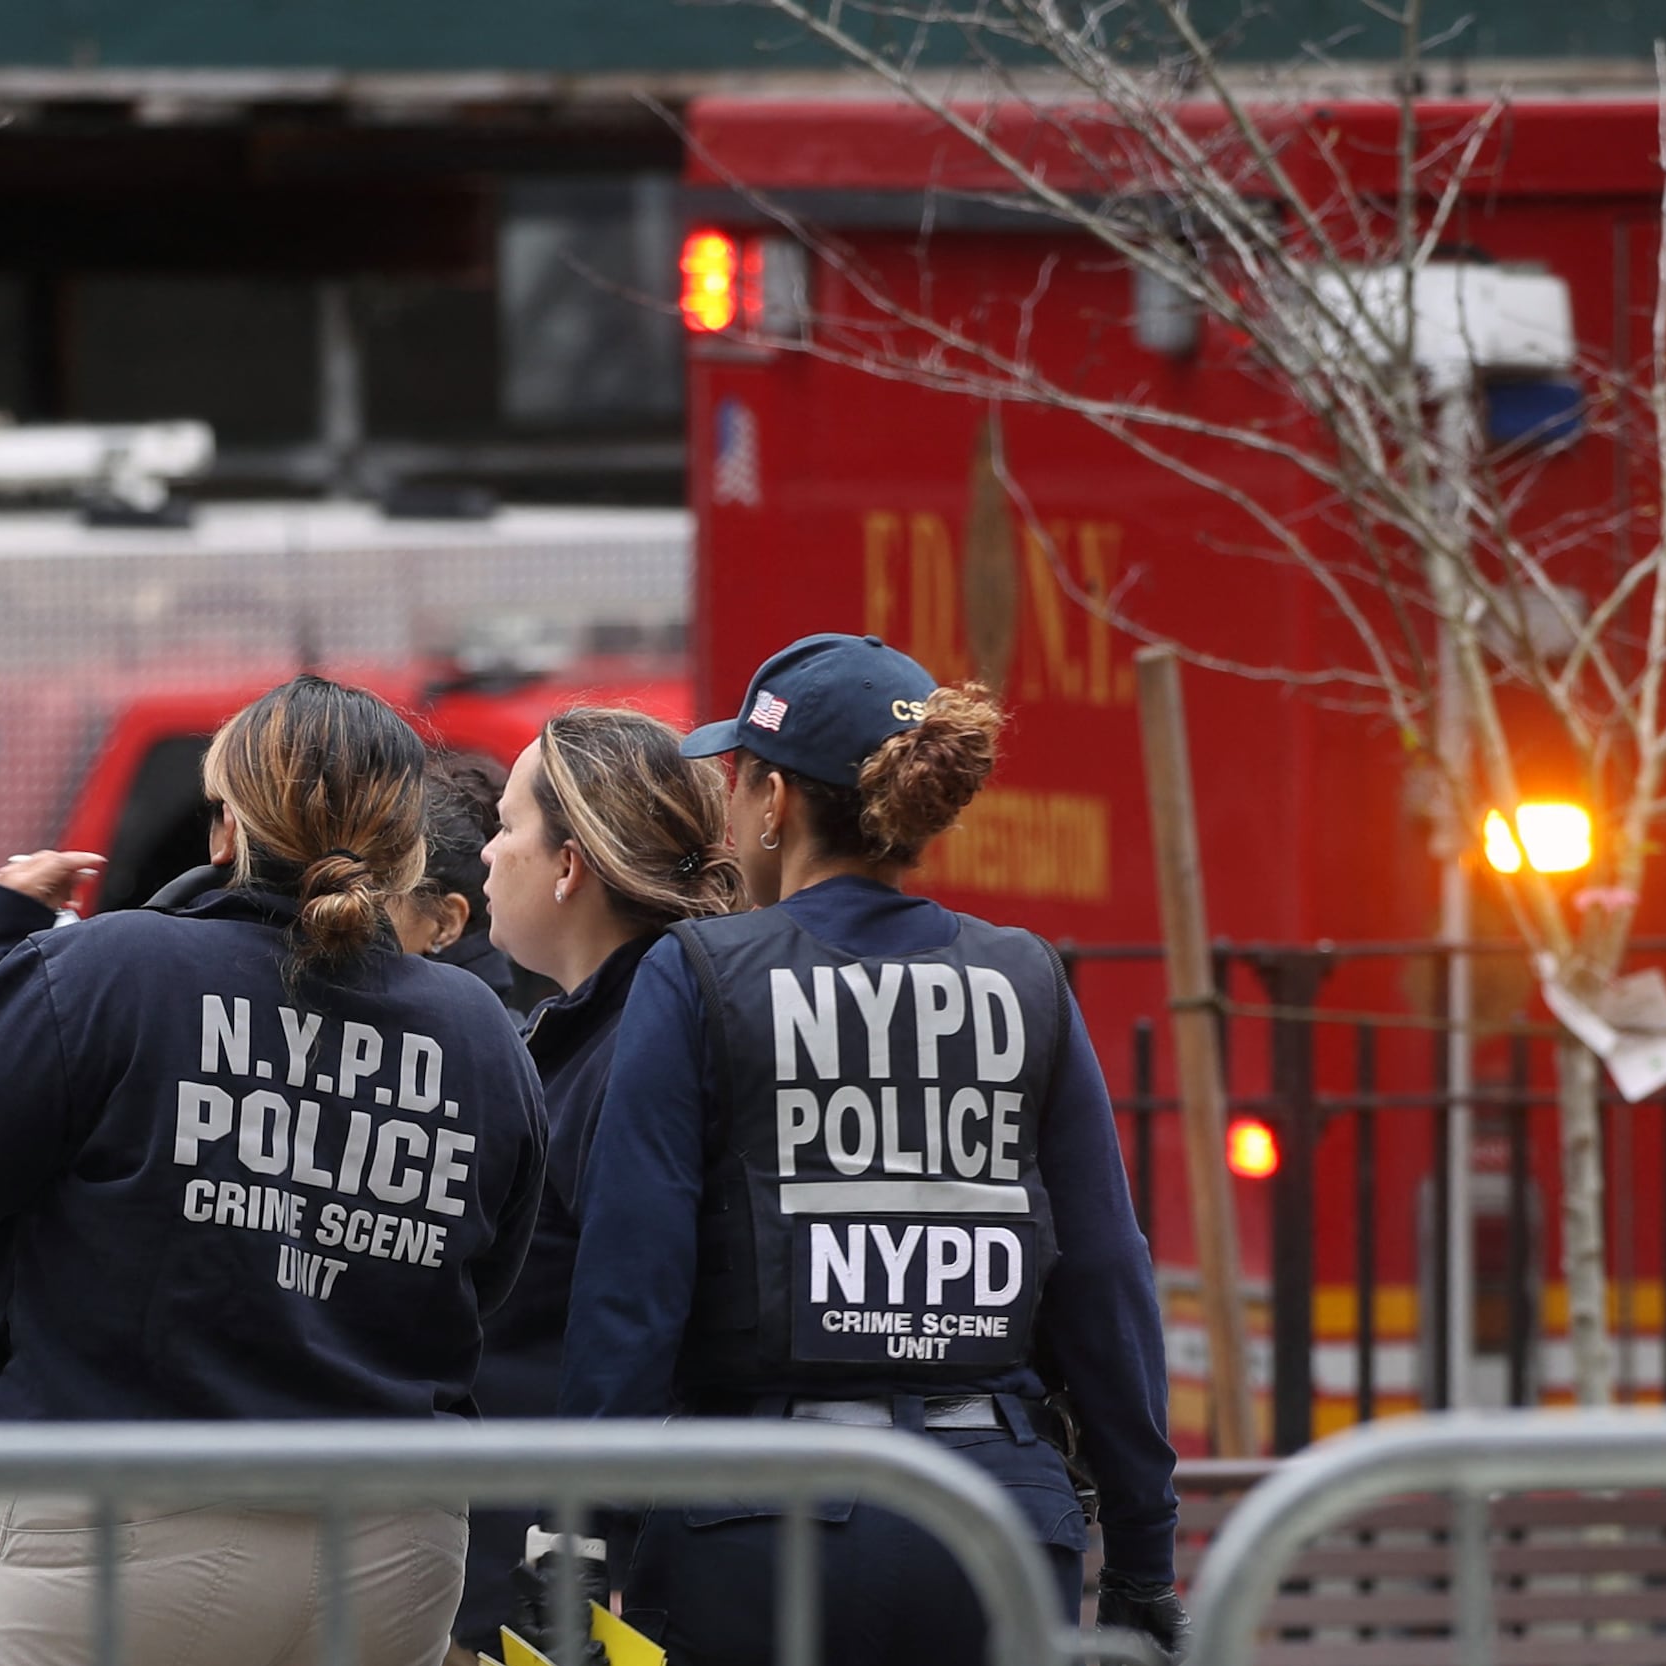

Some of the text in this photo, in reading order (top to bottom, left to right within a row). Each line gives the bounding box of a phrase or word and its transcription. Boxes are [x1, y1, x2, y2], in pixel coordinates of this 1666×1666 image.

[891, 699, 929, 722] CS
[200, 994, 460, 1119] N.Y.P.D.
[769, 962, 1026, 1083] NYPD
[173, 1080, 476, 1218] POLICE
[775, 1086, 1025, 1181] POLICE
[183, 1178, 448, 1268] CRIME SCENE
[809, 1222, 1025, 1308] NYPD
[276, 1244, 349, 1302] UNIT
[820, 1309, 1010, 1339] CRIME SCENE
[886, 1334, 952, 1361] UNIT
